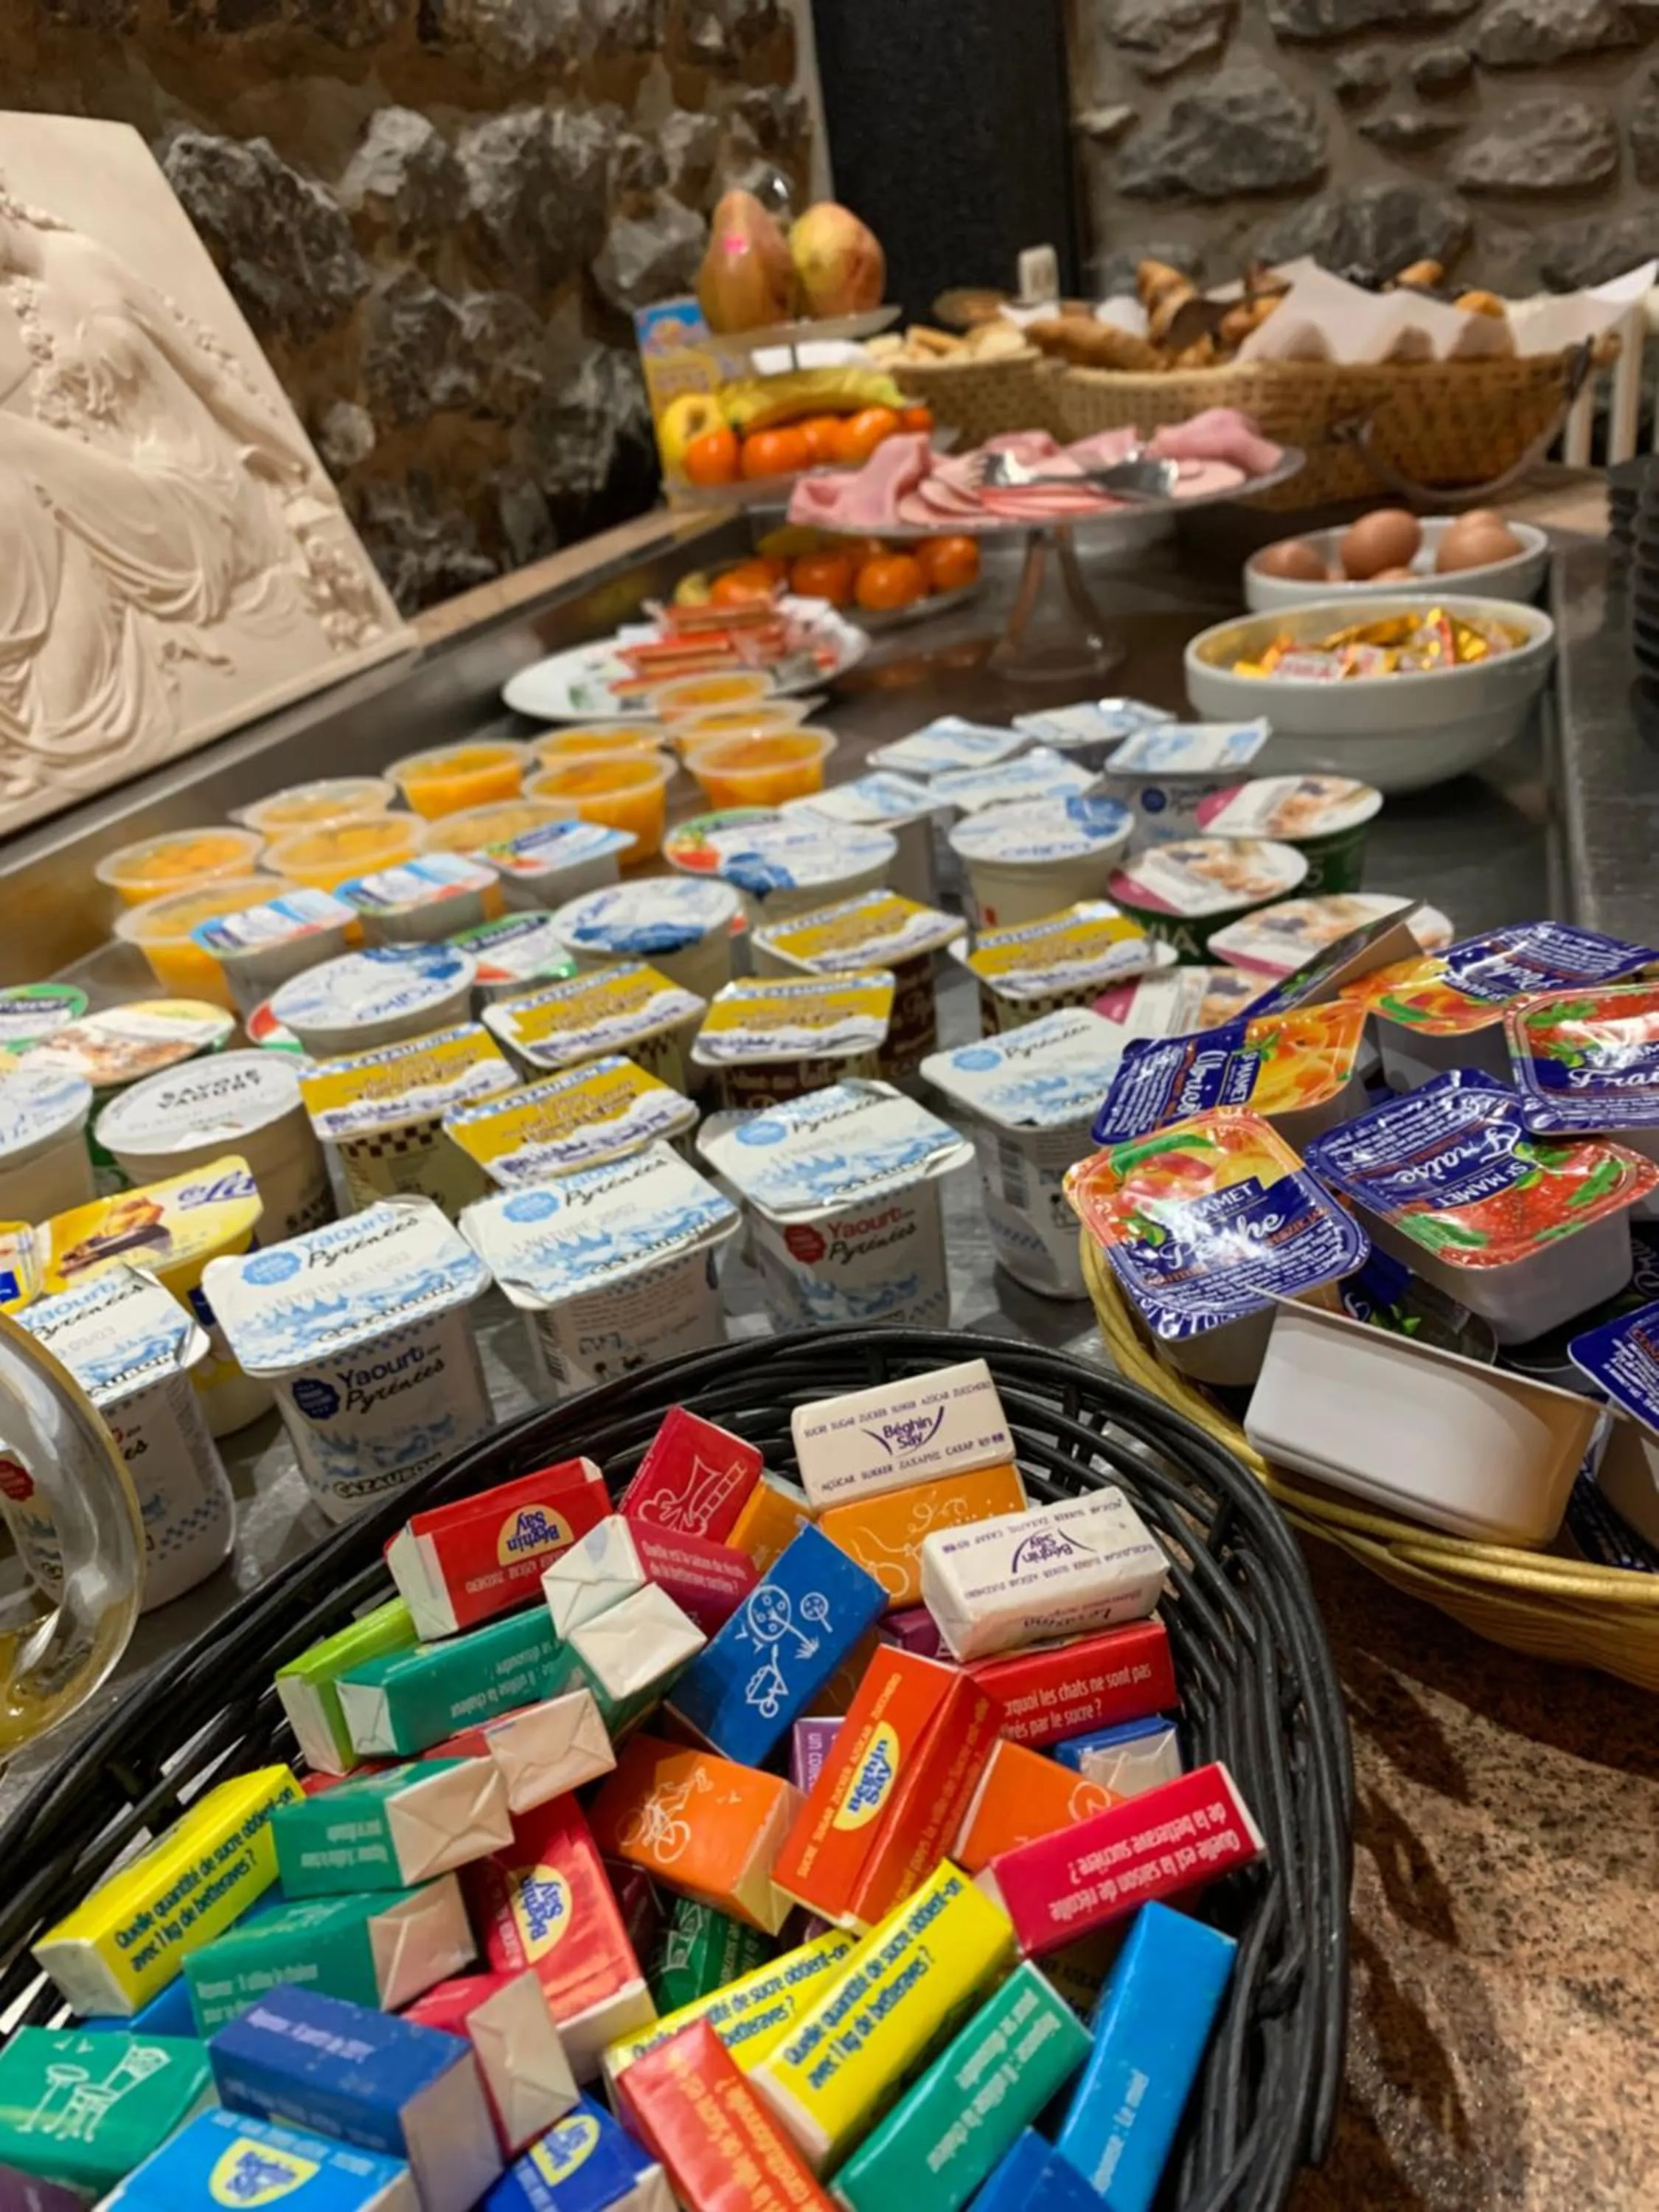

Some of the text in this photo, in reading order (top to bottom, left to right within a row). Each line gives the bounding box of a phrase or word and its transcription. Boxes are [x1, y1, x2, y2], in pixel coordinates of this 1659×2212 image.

[1438, 1172, 1509, 1208] MAMET
[336, 1346, 425, 1391] Yaourt
[830, 1416, 855, 1432] SUGAR
[858, 1408, 888, 1424] ZUCKER
[883, 1414, 933, 1440] Béghin
[896, 1431, 923, 1450] Say
[515, 1510, 548, 1537] Say
[506, 1523, 560, 1553] Béghin
[1039, 1688, 1059, 1705] les
[1058, 1677, 1089, 1702] chats
[1089, 1677, 1105, 1694] ne
[1105, 1666, 1132, 1688] sont
[1132, 1663, 1152, 1685] pas
[1029, 1717, 1051, 1737] par
[1064, 1705, 1094, 1725] sucre
[1193, 1809, 1211, 1832] la
[1206, 1802, 1228, 1825] de
[1133, 1815, 1196, 1848] betterave
[1197, 1829, 1241, 1861] Quelle
[1161, 1854, 1178, 1878] la
[1176, 1845, 1197, 1865] est
[1119, 1863, 1161, 1888] saison
[115, 1910, 155, 1950] Quelle
[198, 1857, 216, 1877] de
[212, 1834, 243, 1865] sucre
[1099, 1880, 1119, 1904] de
[178, 1907, 197, 1928] de
[731, 1994, 748, 2012] de
[750, 1976, 784, 2003] sucre
[783, 2023, 826, 2067] Quelle
[865, 1952, 887, 1980] de
[883, 1925, 912, 1966] sucre
[807, 2054, 840, 2090] avec
[854, 2008, 874, 2034] de
[867, 1954, 931, 2022] betteraves
